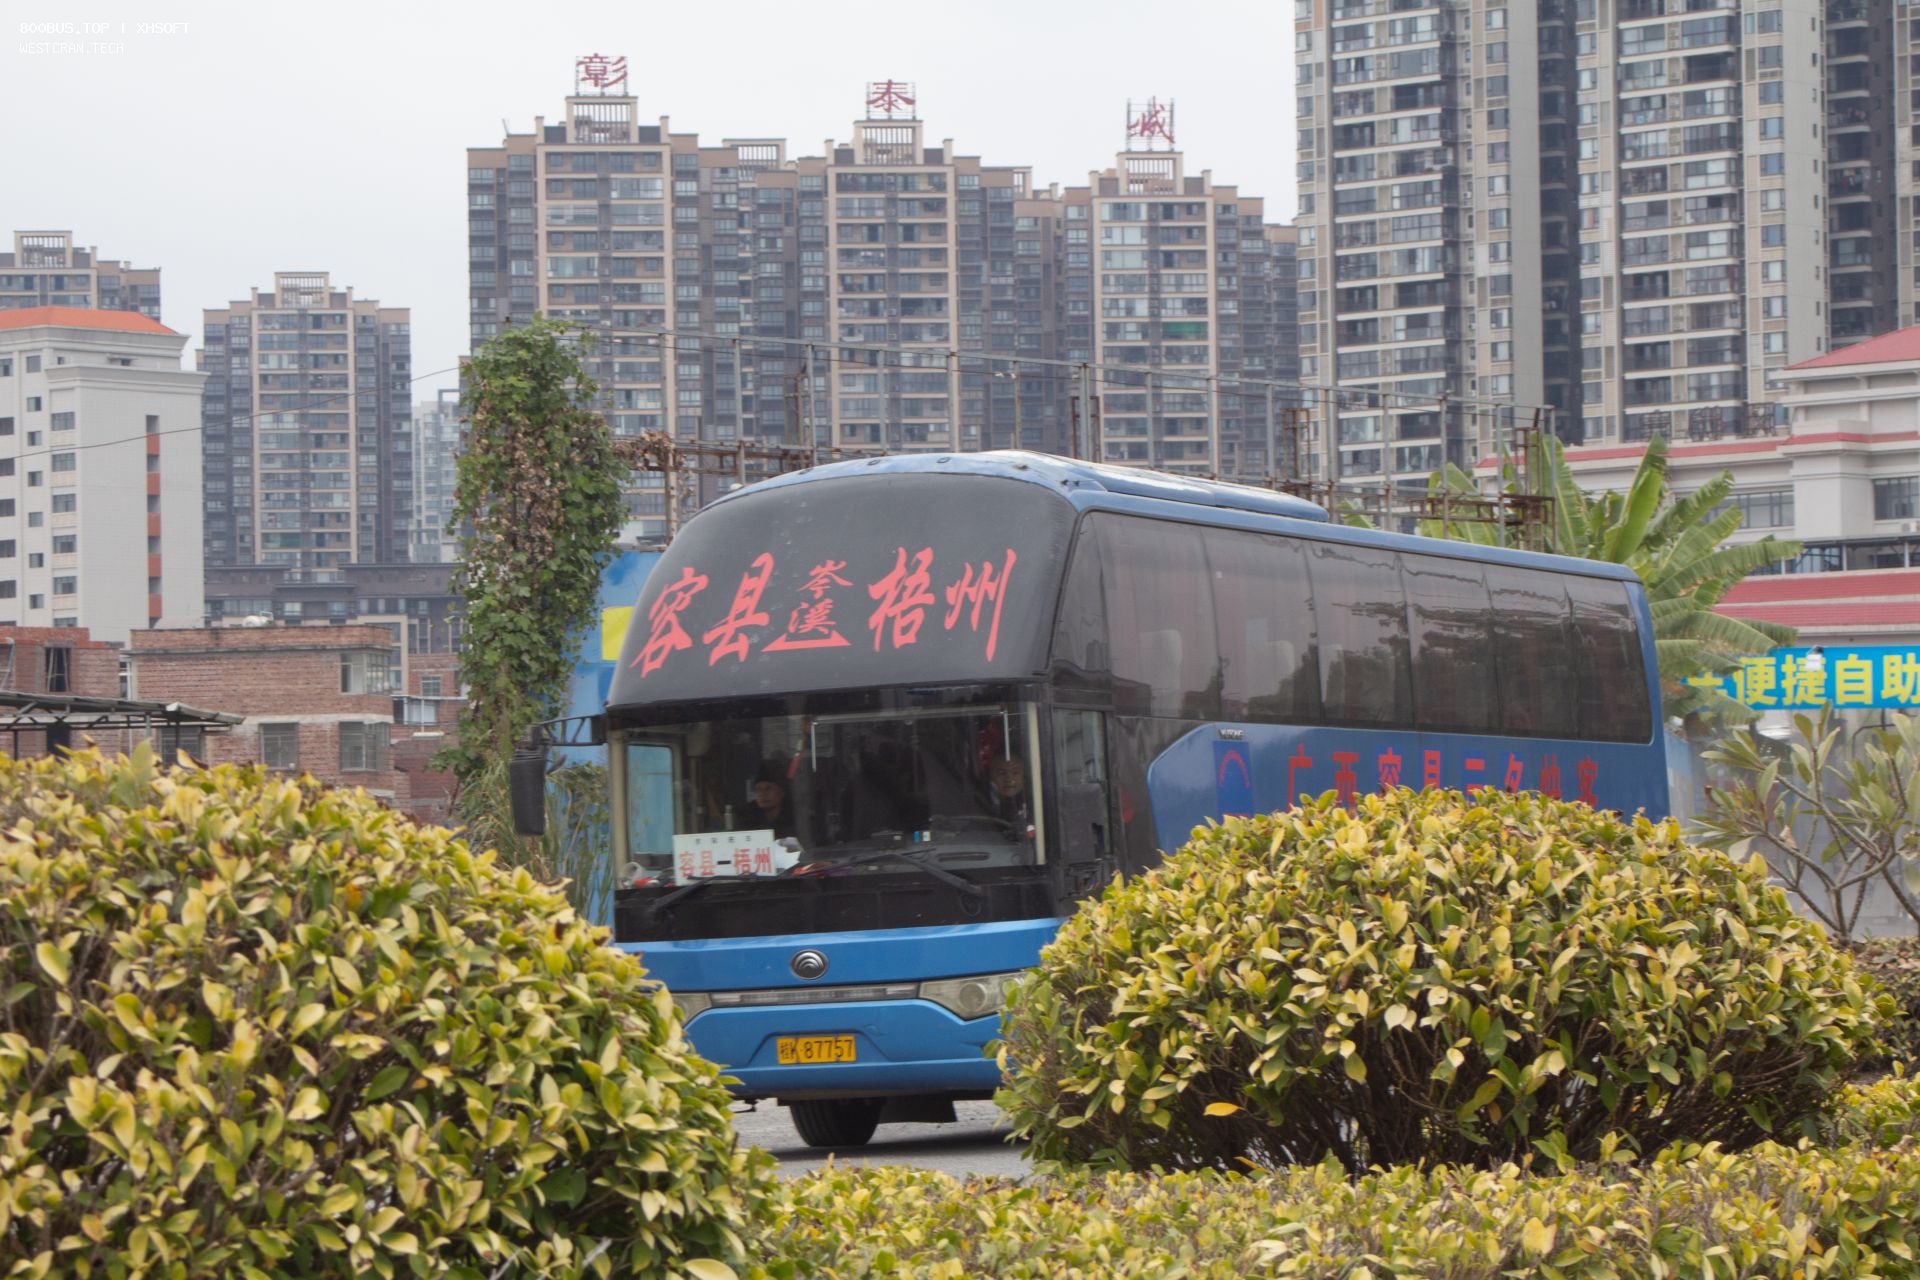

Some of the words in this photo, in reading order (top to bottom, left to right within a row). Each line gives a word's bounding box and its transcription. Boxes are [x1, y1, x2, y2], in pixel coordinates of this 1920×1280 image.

[576, 53, 627, 87] 彰
[866, 79, 915, 113] 泰
[867, 546, 1017, 662] 梧州
